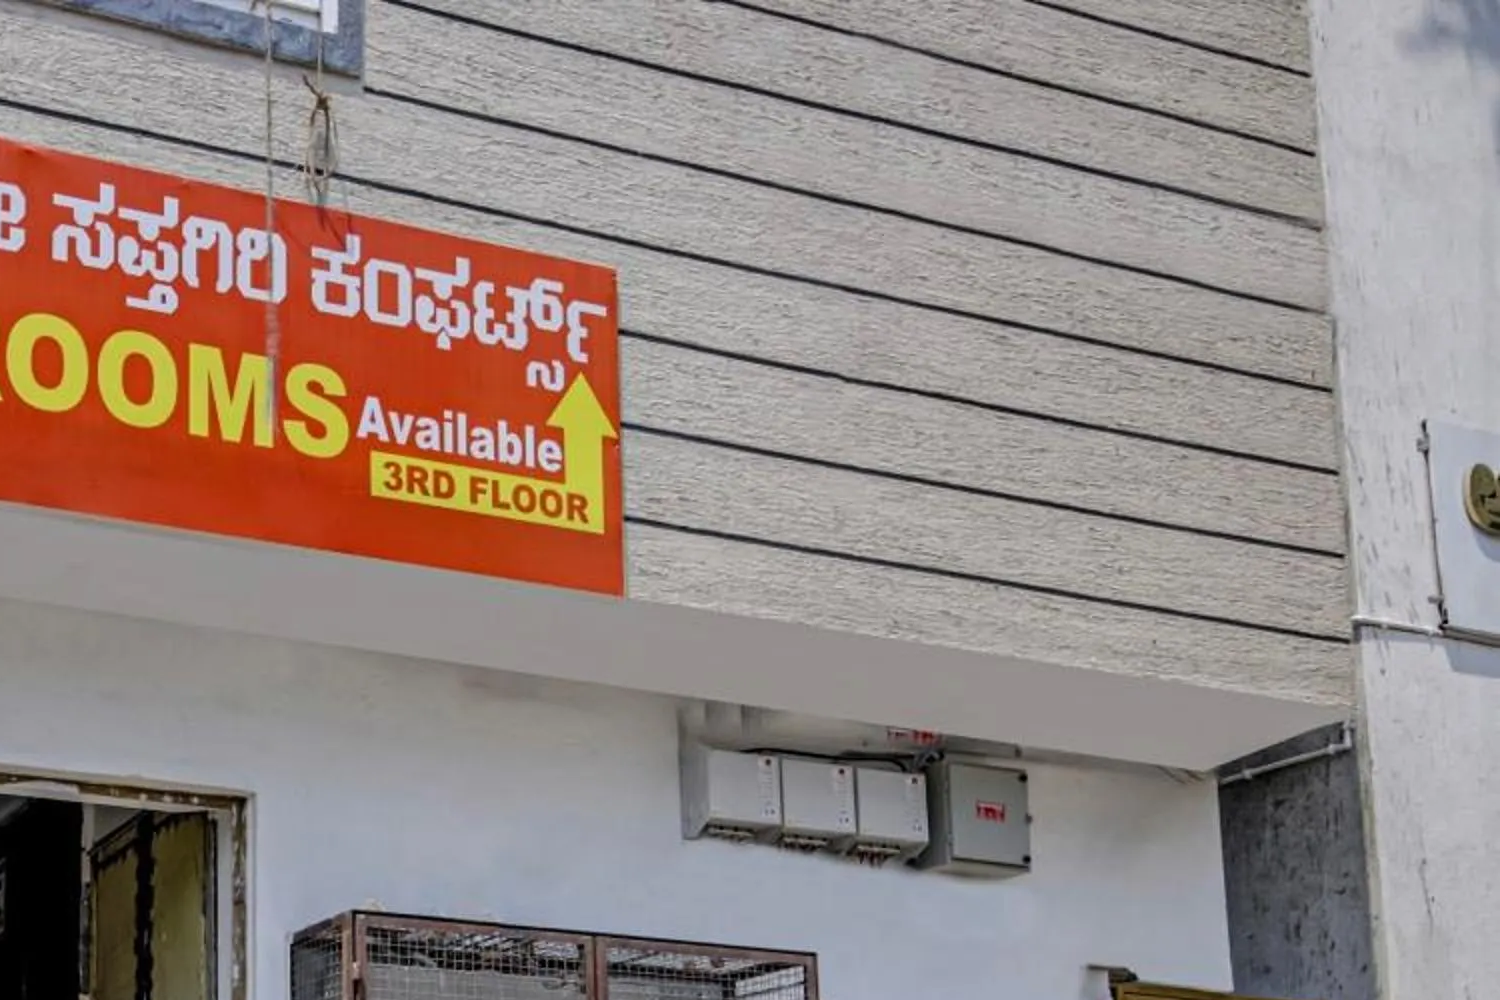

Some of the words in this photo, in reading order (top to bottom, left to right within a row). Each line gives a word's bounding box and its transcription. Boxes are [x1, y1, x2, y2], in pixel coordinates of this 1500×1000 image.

[50, 181, 289, 316] ಸಪ್ತಗಿರಿ
[356, 395, 564, 473] Available
[382, 460, 456, 500] 3RD
[468, 476, 590, 525] FLOOR
